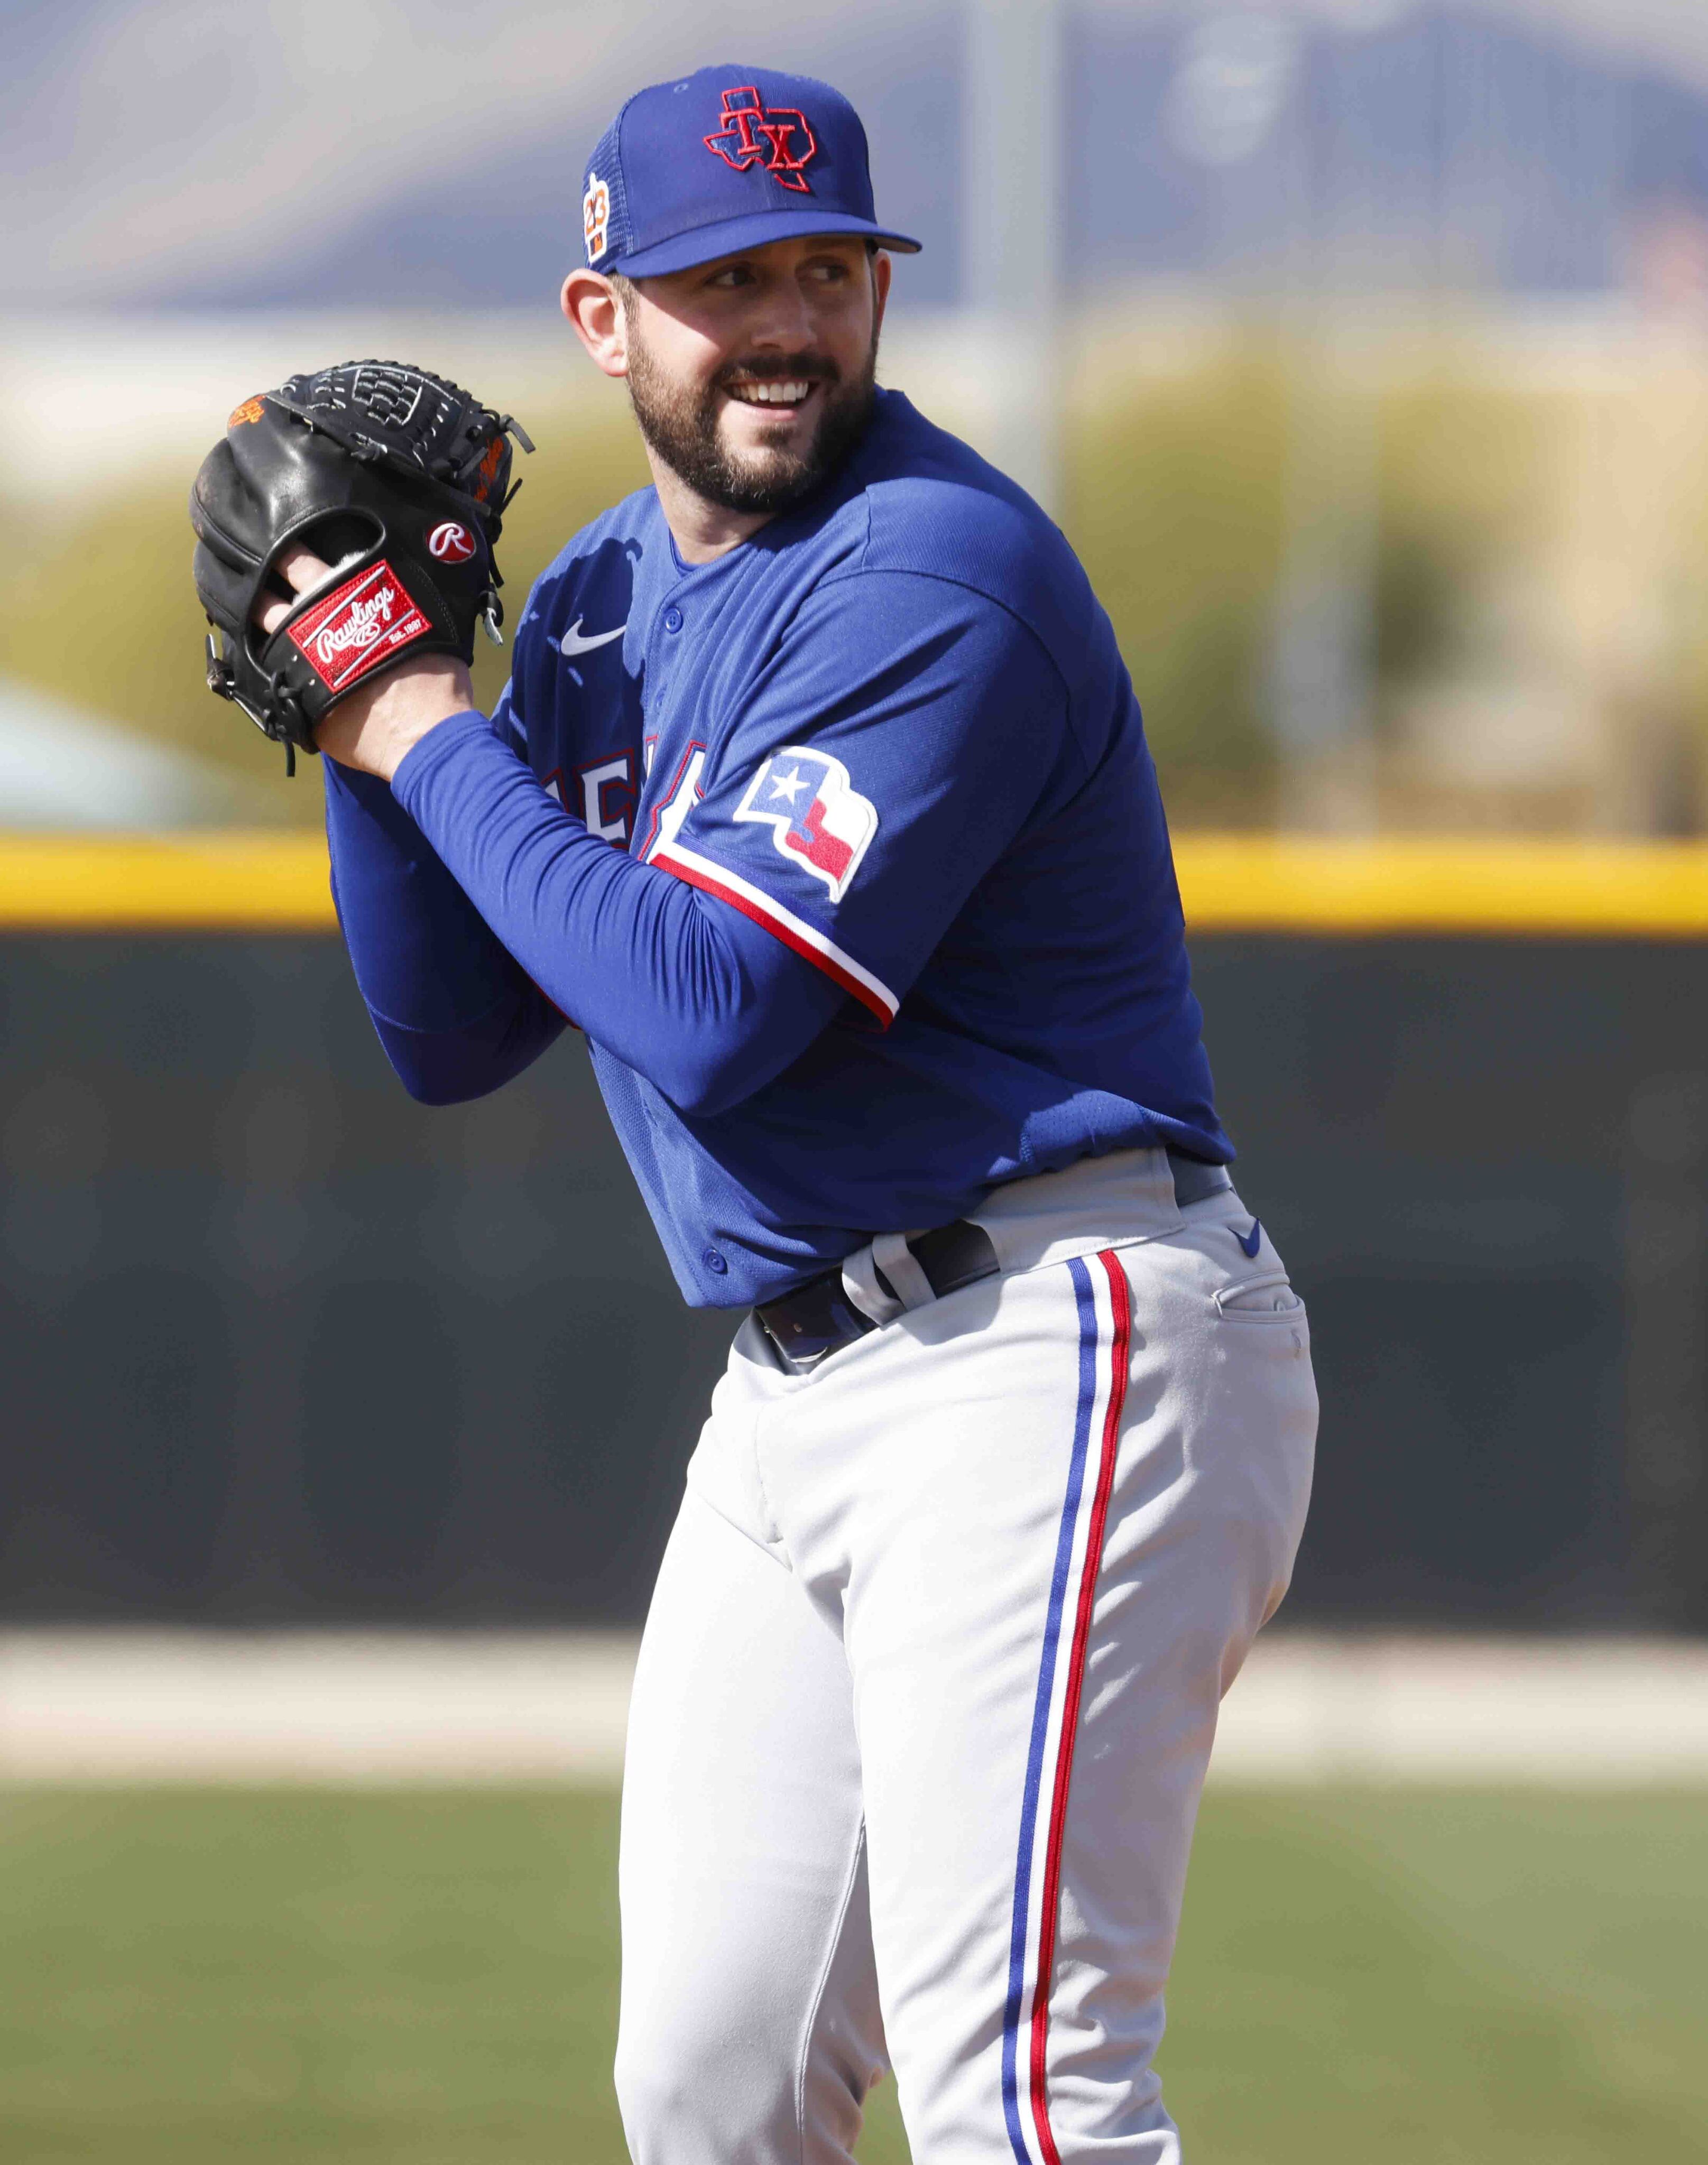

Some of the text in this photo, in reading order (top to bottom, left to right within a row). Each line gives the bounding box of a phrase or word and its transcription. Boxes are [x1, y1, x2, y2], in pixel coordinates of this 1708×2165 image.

[719, 108, 804, 170] TX
[429, 523, 472, 557] R
[317, 587, 395, 664] Rawlings
